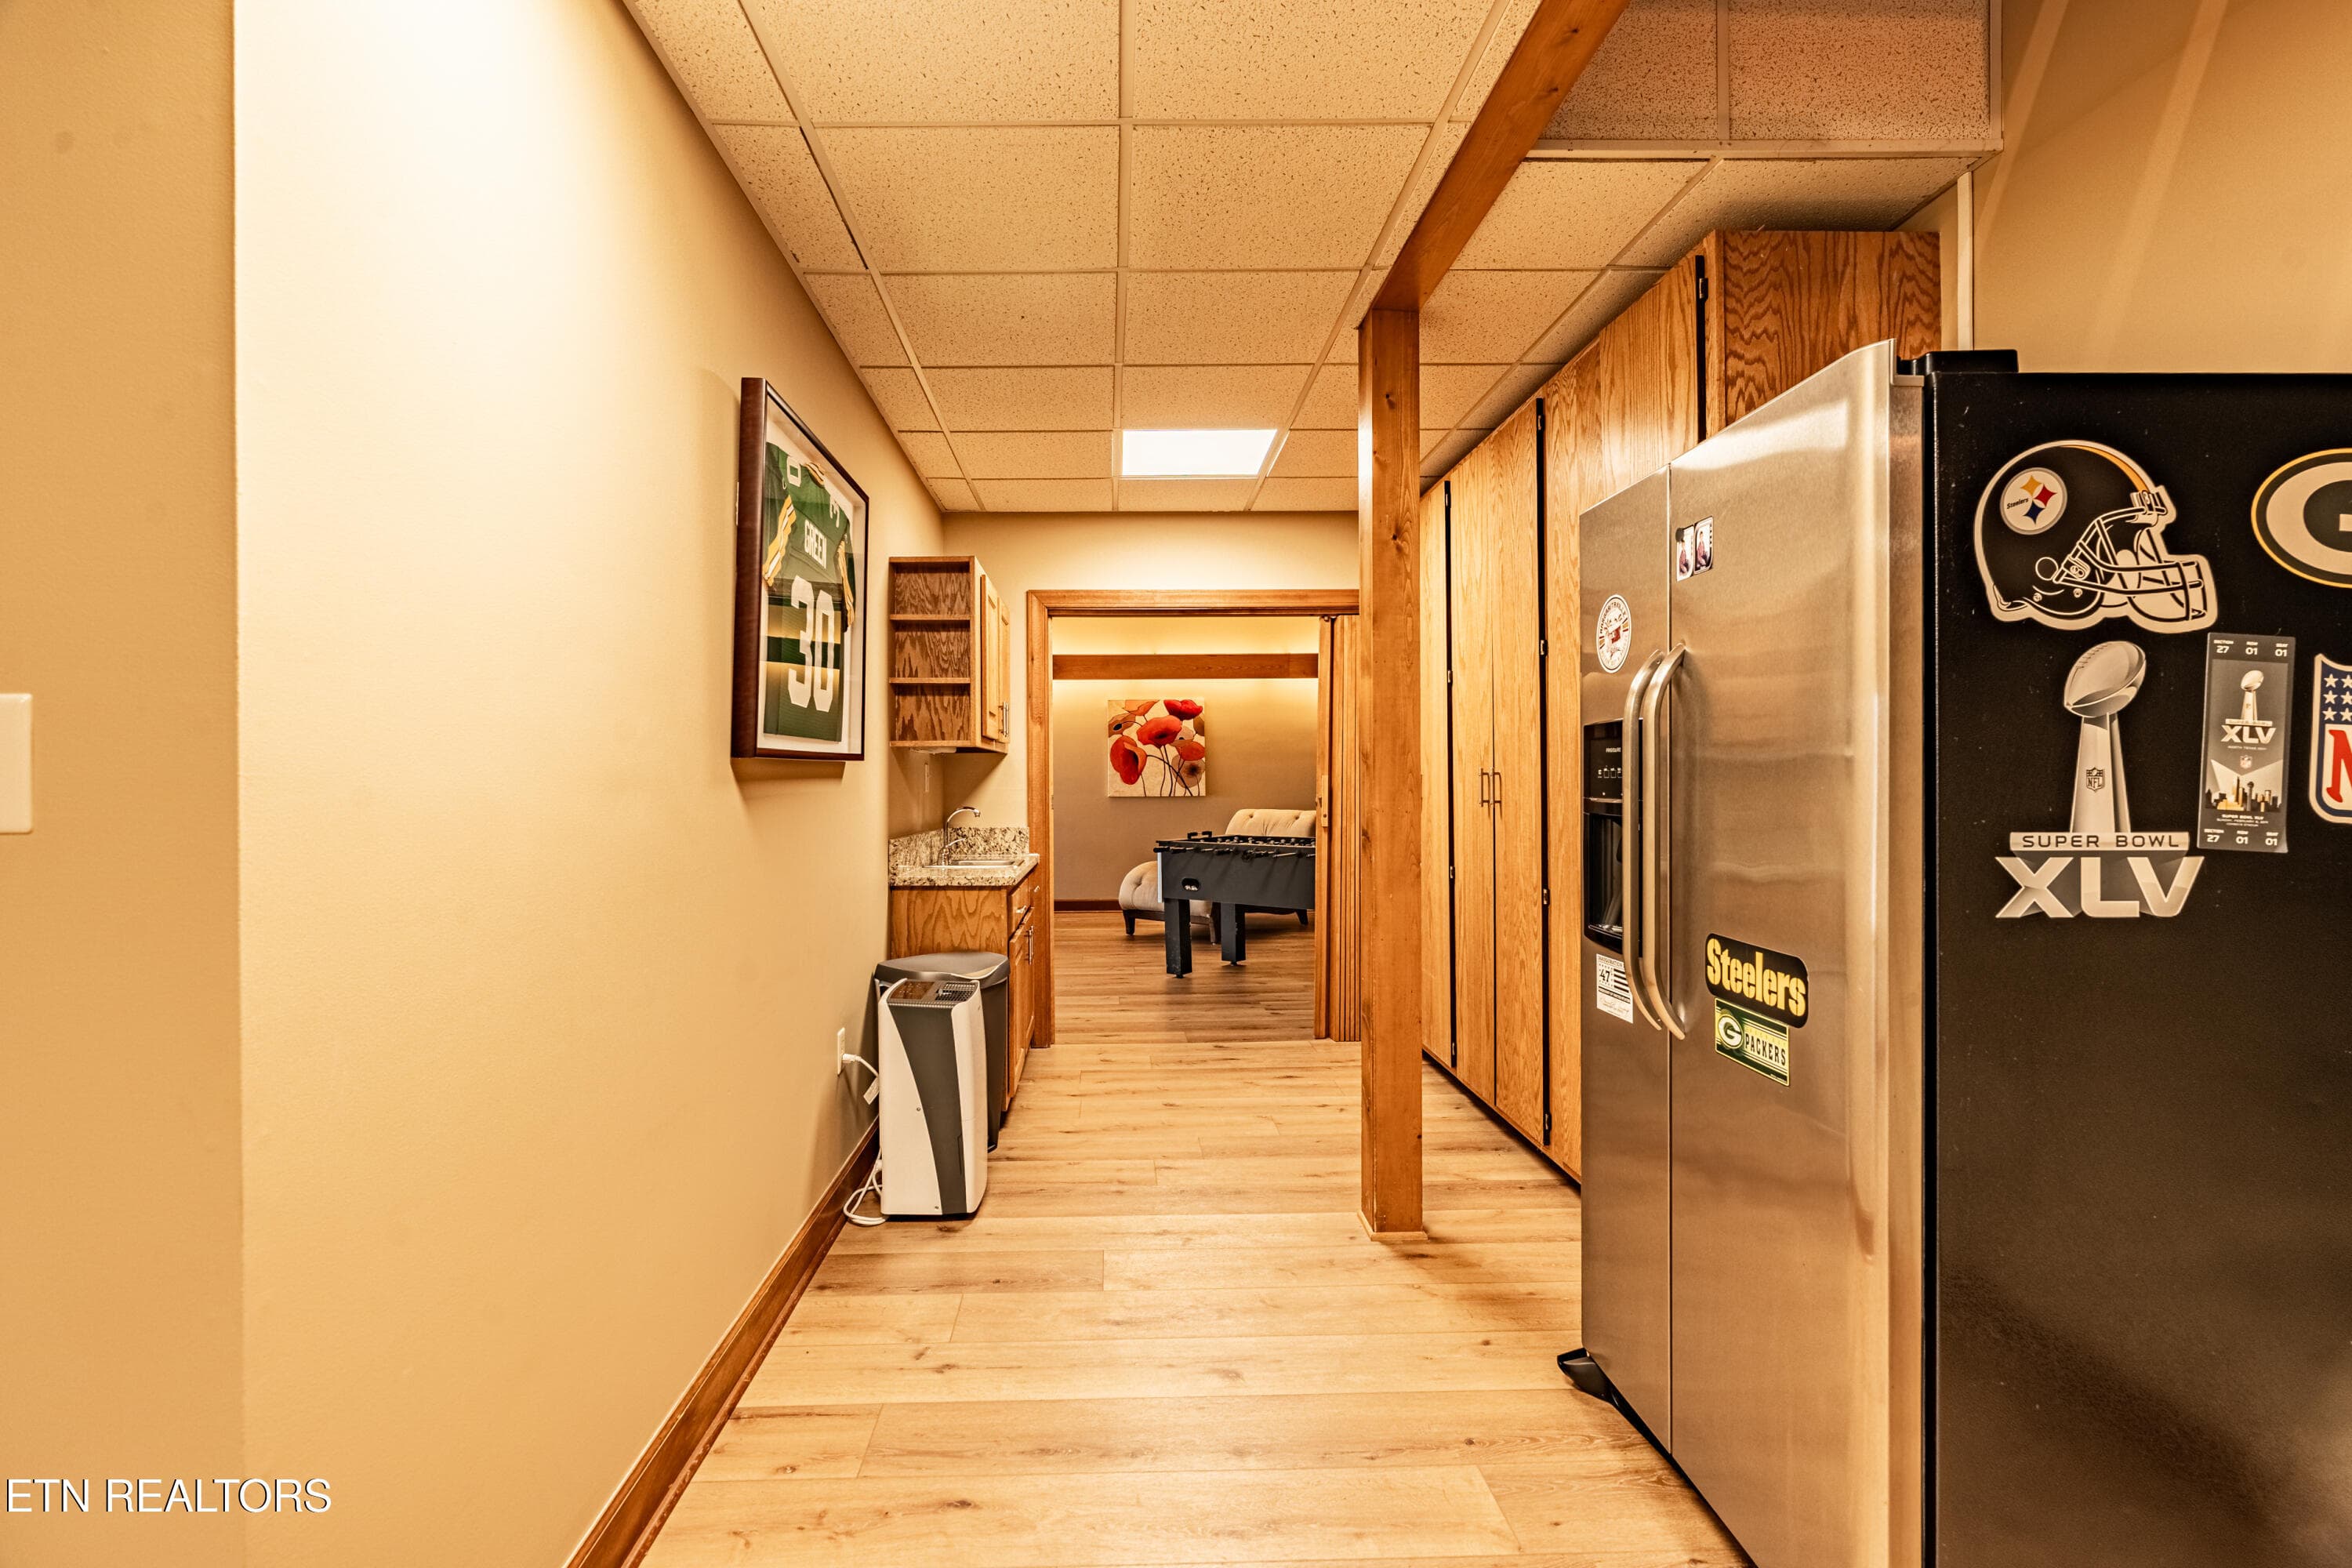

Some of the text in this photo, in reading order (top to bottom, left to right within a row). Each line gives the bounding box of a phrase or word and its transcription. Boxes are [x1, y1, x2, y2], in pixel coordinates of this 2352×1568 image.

[2007, 498, 2029, 510] Steelers
[804, 519, 826, 569] GREEN
[788, 575, 834, 712] 30
[2220, 725, 2277, 744] XLV
[2087, 777, 2101, 788] NFL
[2023, 835, 2180, 848] SUPER BOWL
[2207, 834, 2220, 843] 27
[2235, 836, 2249, 844] 01
[1994, 856, 2205, 918] XLV
[1600, 969, 1610, 982] 47
[1707, 938, 1806, 1017] Steelers
[1745, 1033, 1786, 1066] PACKERS
